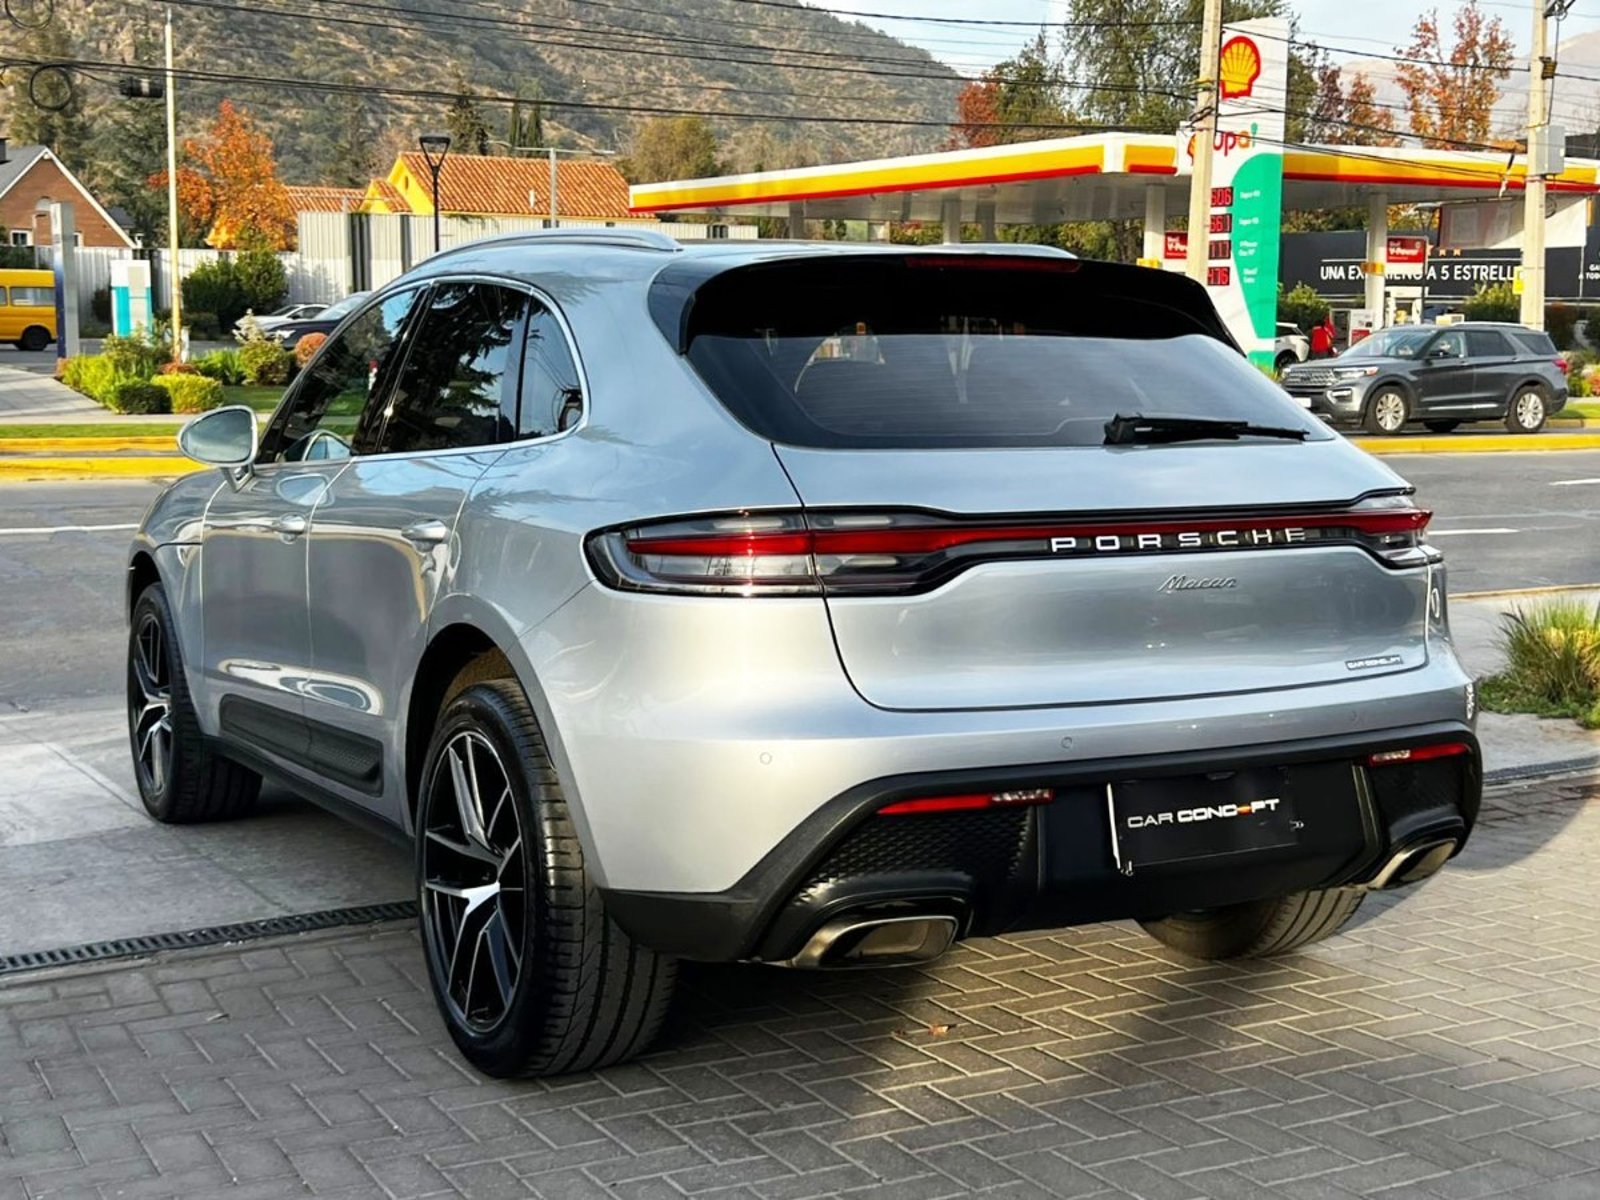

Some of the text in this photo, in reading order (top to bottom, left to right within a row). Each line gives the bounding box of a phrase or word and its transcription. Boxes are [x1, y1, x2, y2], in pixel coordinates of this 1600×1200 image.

[1320, 265, 1346, 281] UNA
[1440, 265, 1450, 280] 5
[1453, 264, 1515, 281] ESTRELL
[1051, 527, 1306, 553] PORSCHE
[1157, 573, 1237, 593] Macan
[1127, 812, 1174, 828] CAR
